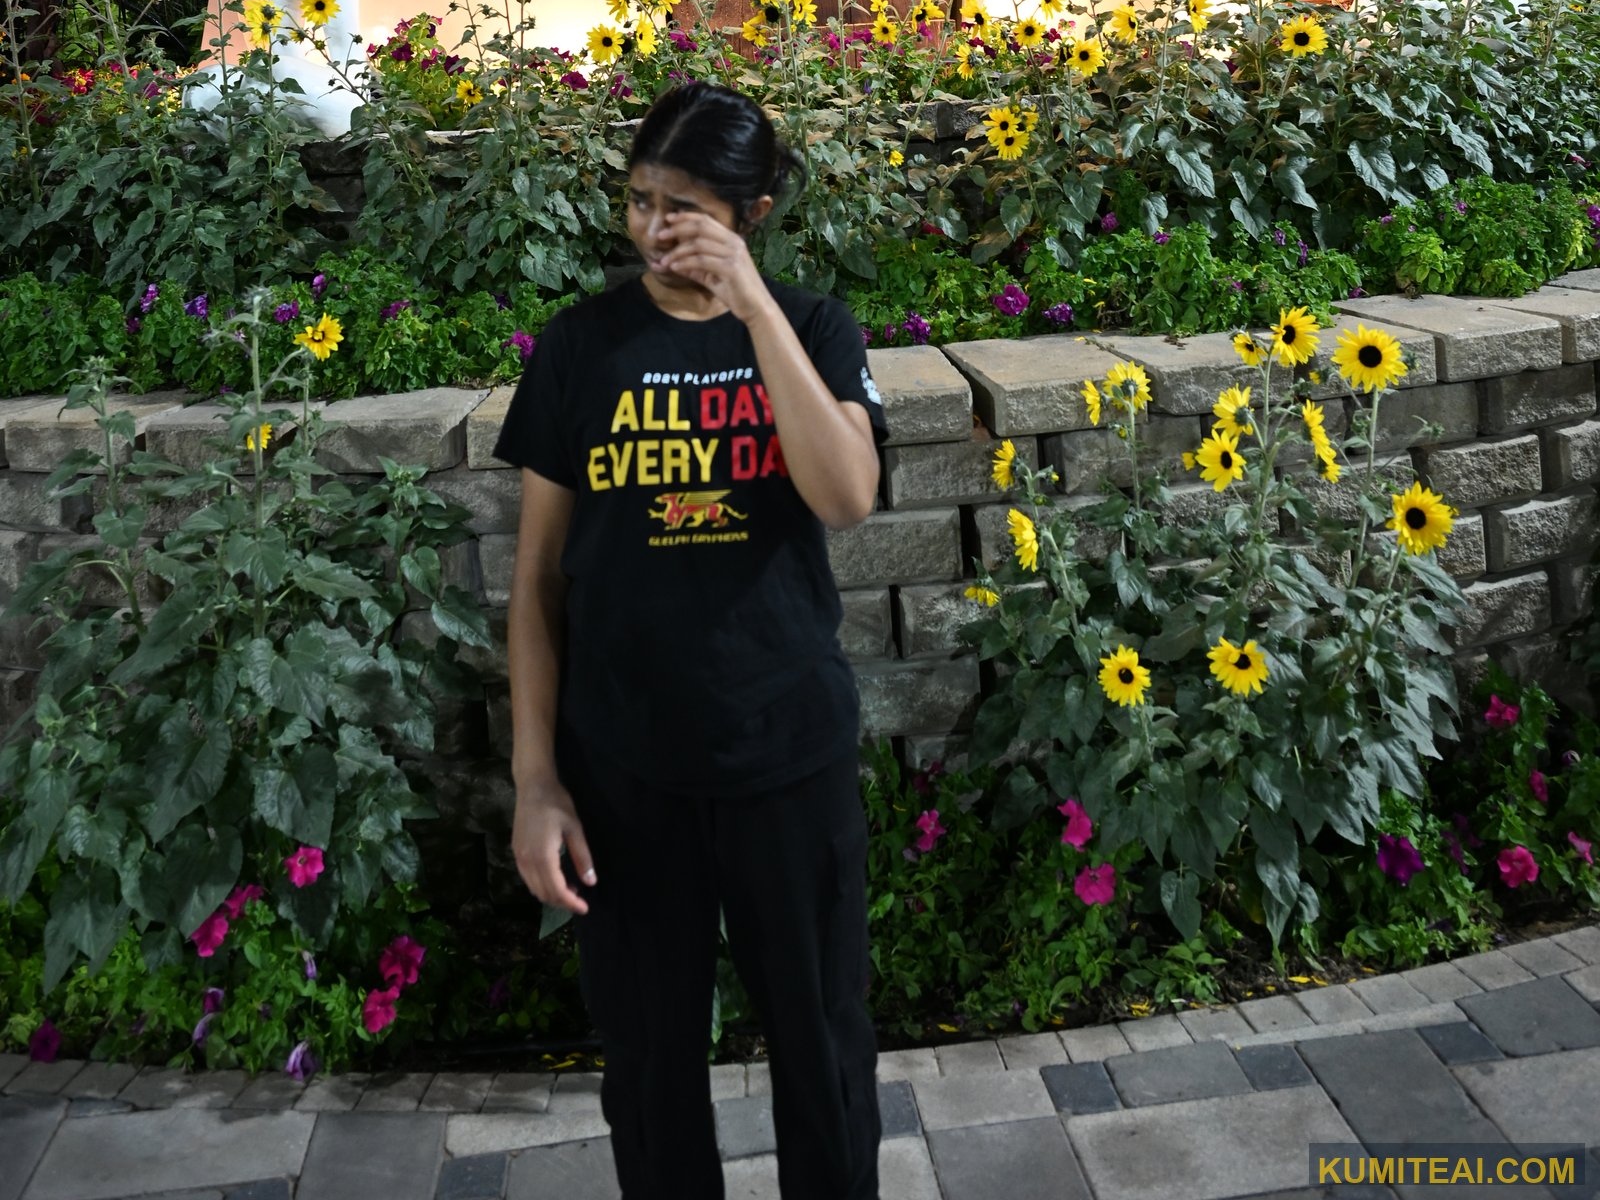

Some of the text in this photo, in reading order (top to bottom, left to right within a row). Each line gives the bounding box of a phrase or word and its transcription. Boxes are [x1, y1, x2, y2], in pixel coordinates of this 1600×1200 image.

[642, 367, 753, 385] 2024 PLAYOFFS
[610, 389, 691, 433] ALL
[587, 436, 789, 491] EVERY DA
